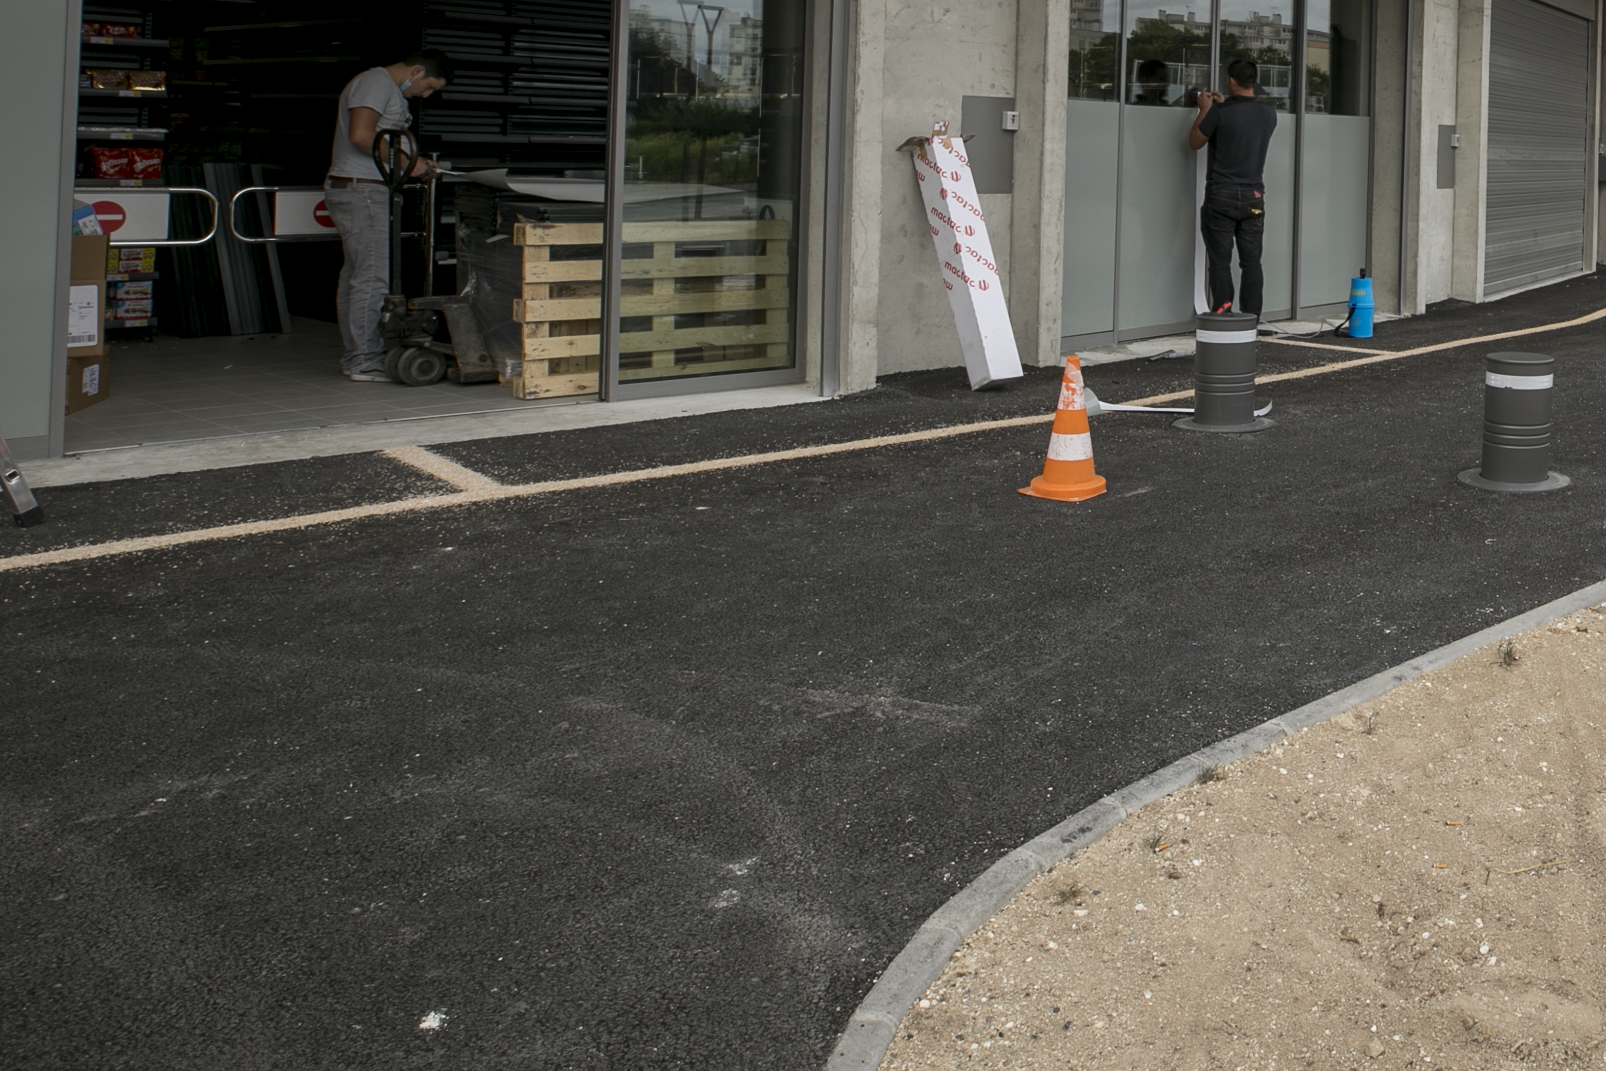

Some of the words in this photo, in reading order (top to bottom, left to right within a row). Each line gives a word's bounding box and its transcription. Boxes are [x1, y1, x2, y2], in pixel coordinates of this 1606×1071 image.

[917, 153, 948, 179] mactac
[930, 207, 962, 233] mactac
[944, 261, 976, 288] mactac
